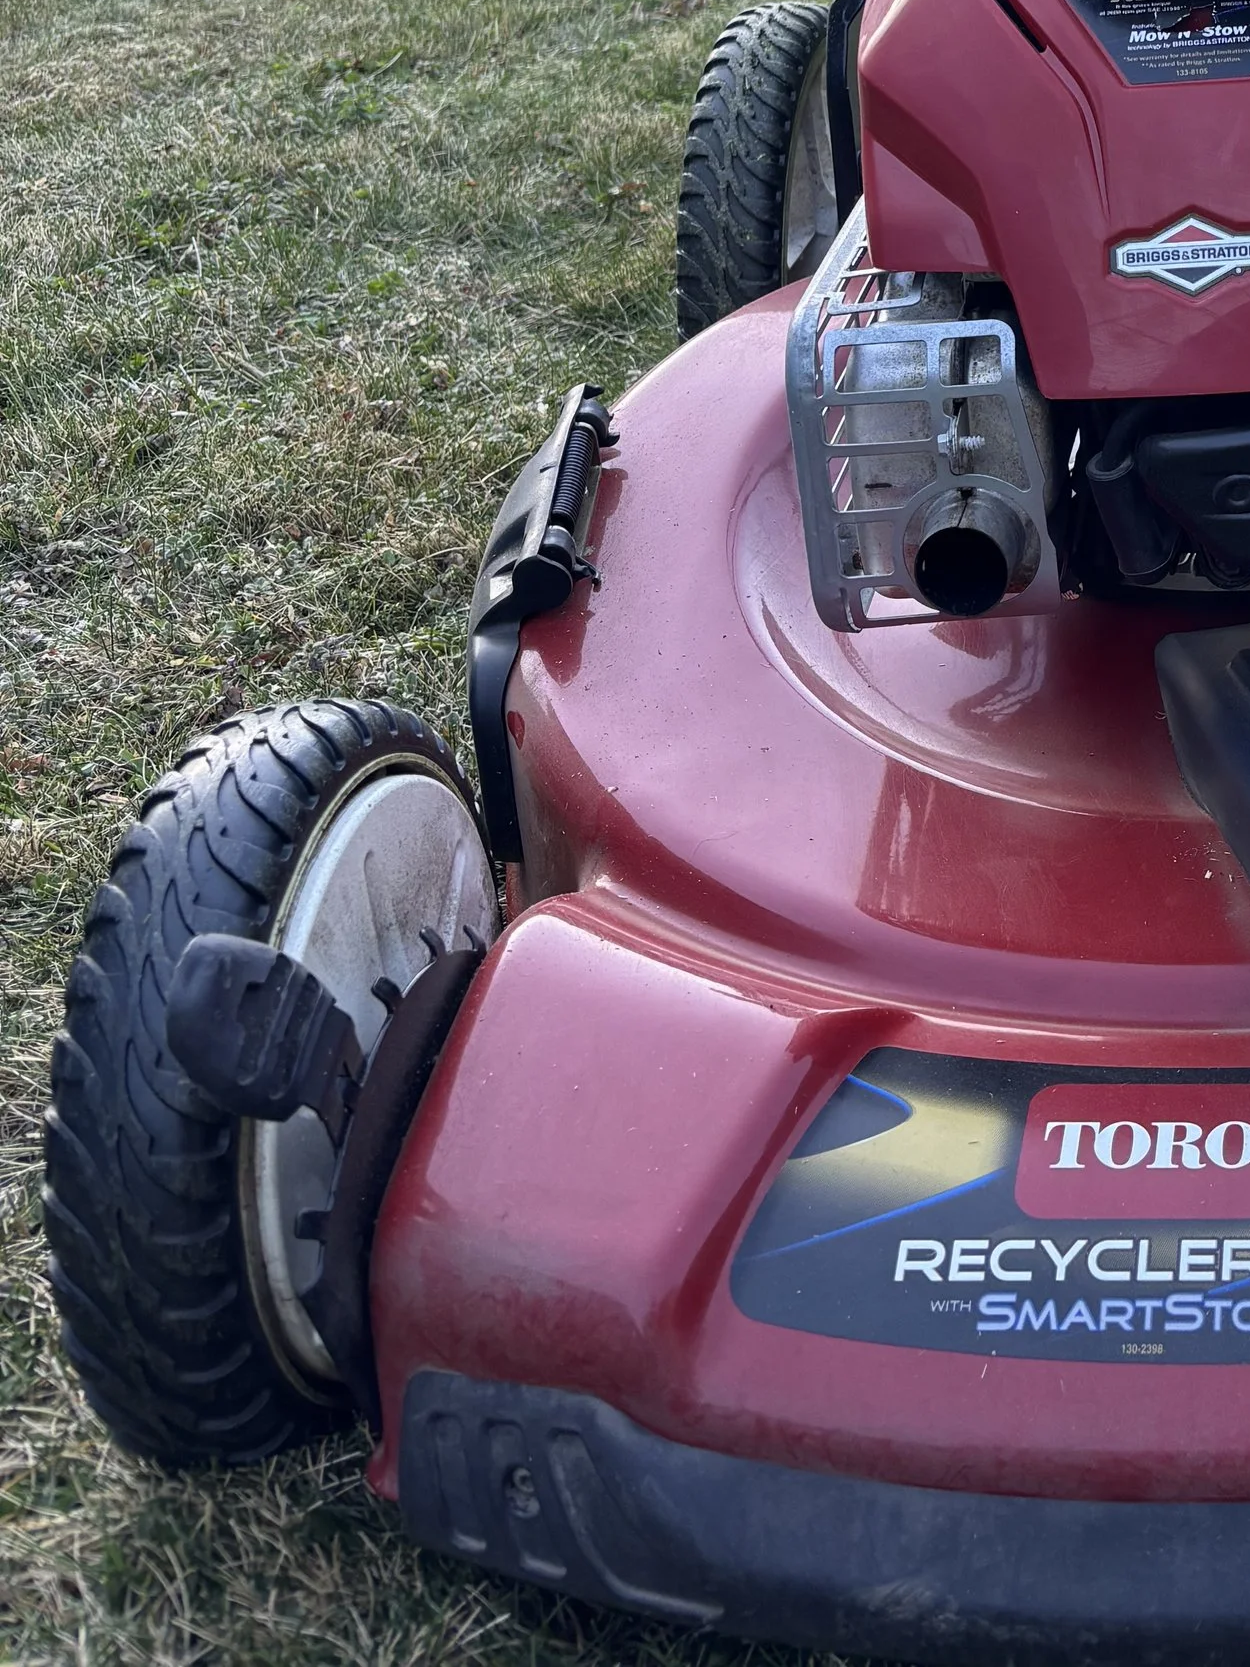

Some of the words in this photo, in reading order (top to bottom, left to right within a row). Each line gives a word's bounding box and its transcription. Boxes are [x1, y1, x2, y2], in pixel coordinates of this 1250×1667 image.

[1129, 30, 1171, 43] Mow
[930, 1300, 972, 1313] WITH
[1121, 1343, 1164, 1355] 130-2398
